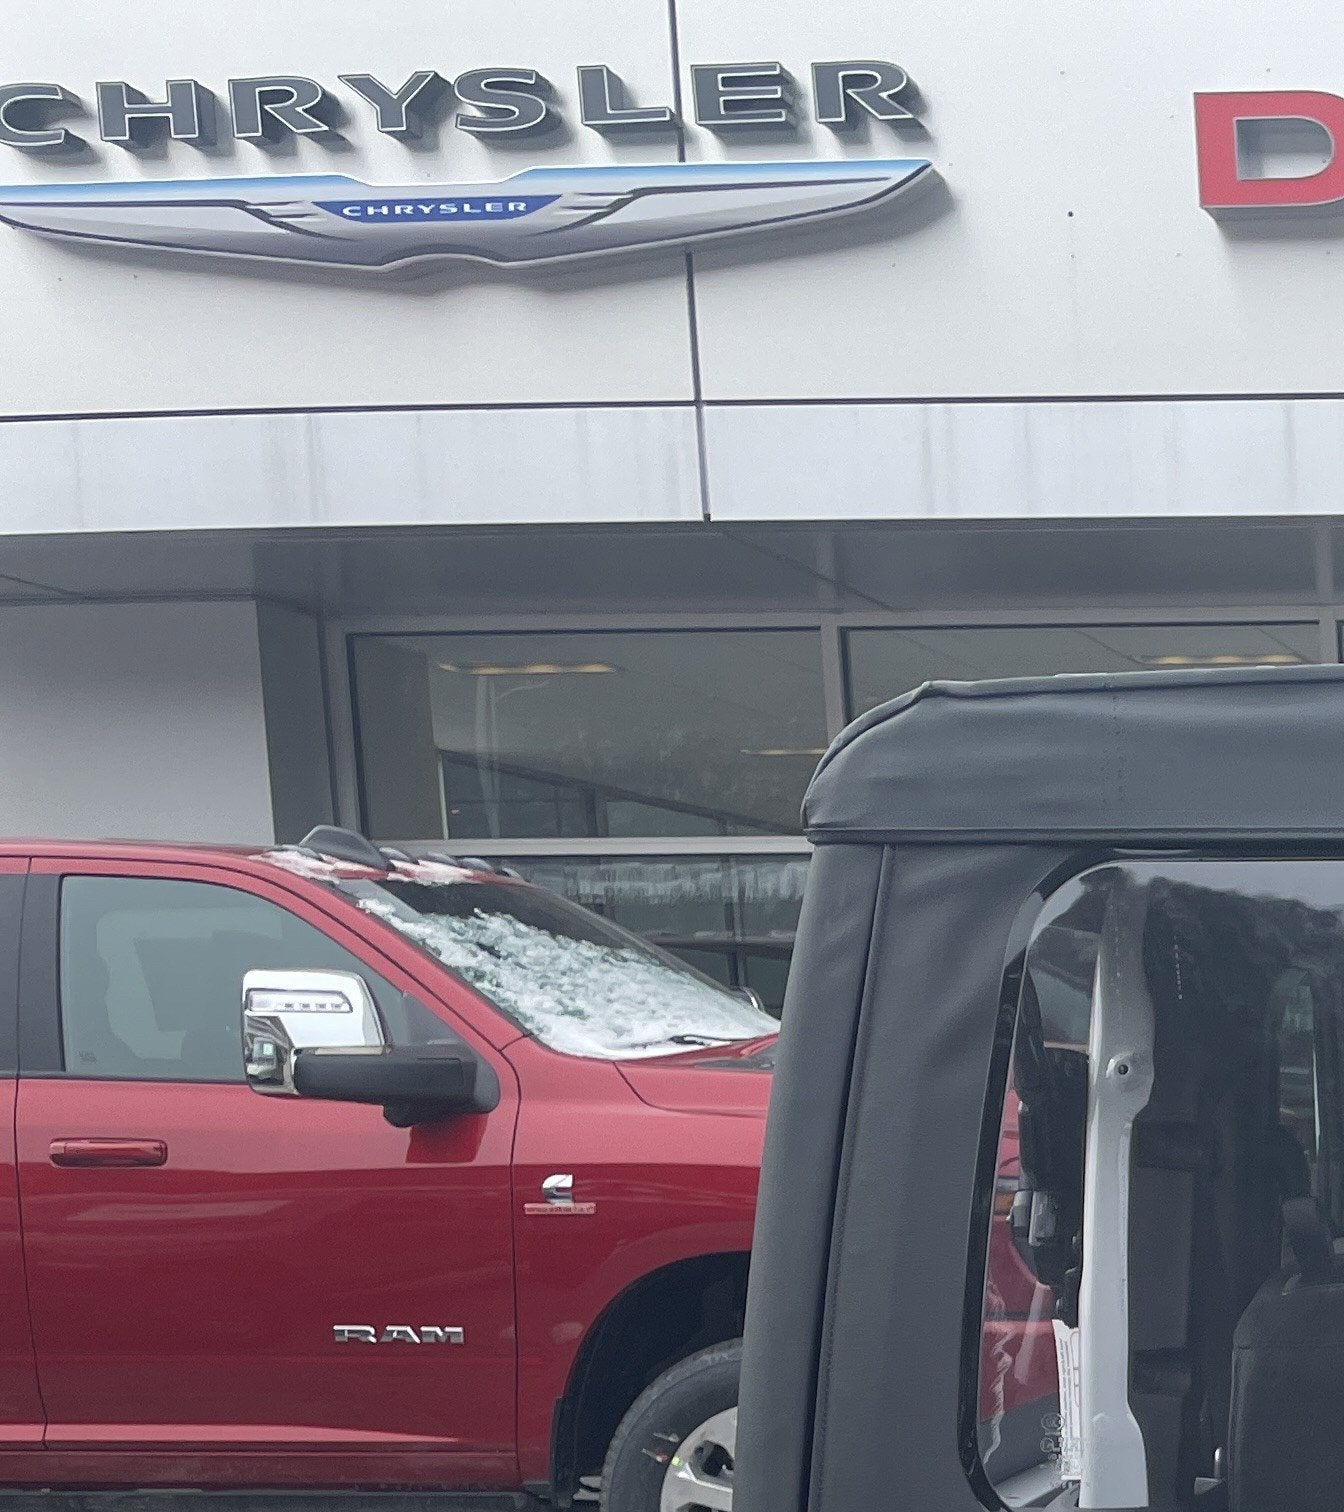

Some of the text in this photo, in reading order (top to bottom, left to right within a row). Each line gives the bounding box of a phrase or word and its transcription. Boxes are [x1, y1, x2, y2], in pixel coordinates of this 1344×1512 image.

[0, 60, 914, 149] CHRYSLER
[342, 201, 527, 217] CHRYSLER
[333, 1325, 464, 1343] RAM
